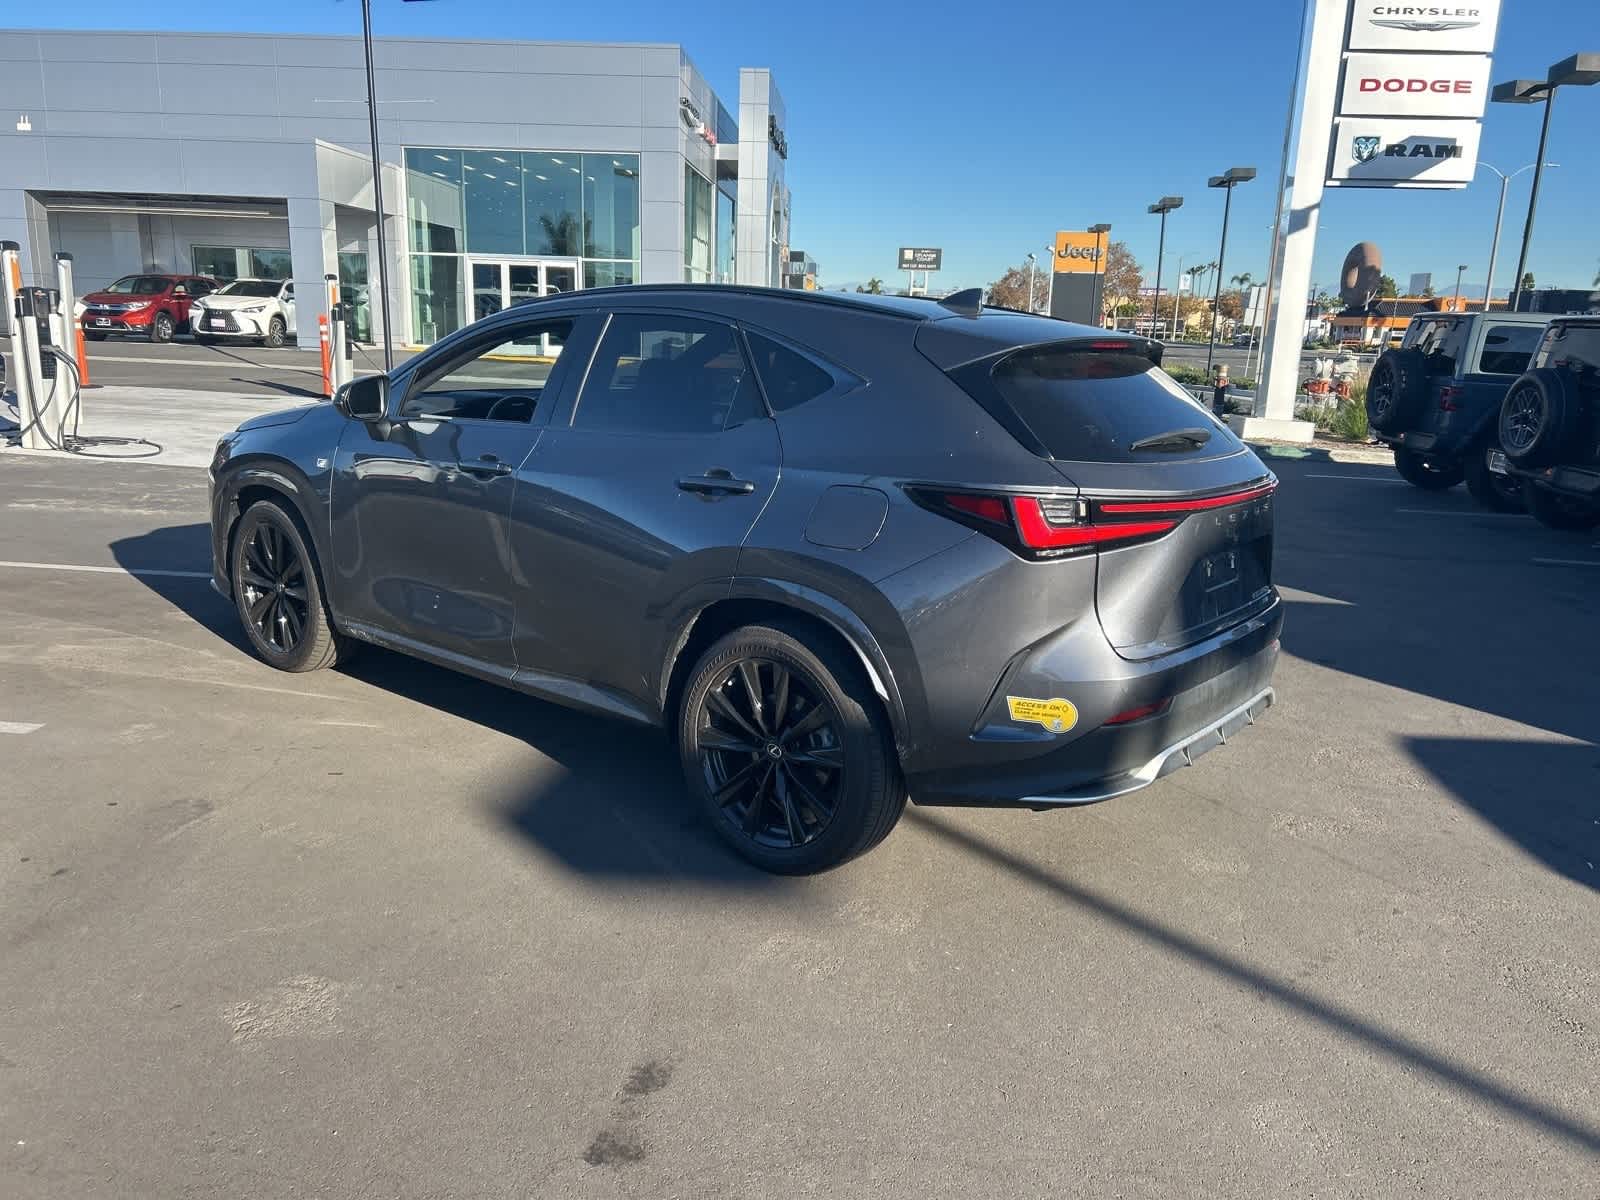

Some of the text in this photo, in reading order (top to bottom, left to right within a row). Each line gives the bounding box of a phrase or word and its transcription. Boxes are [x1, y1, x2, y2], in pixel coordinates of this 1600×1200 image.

[1373, 6, 1480, 17] CHRYSLER
[1360, 78, 1473, 94] DODGE
[1384, 144, 1463, 159] RAM
[1058, 243, 1104, 262] Jeep
[1015, 701, 1048, 710] ACCESS
